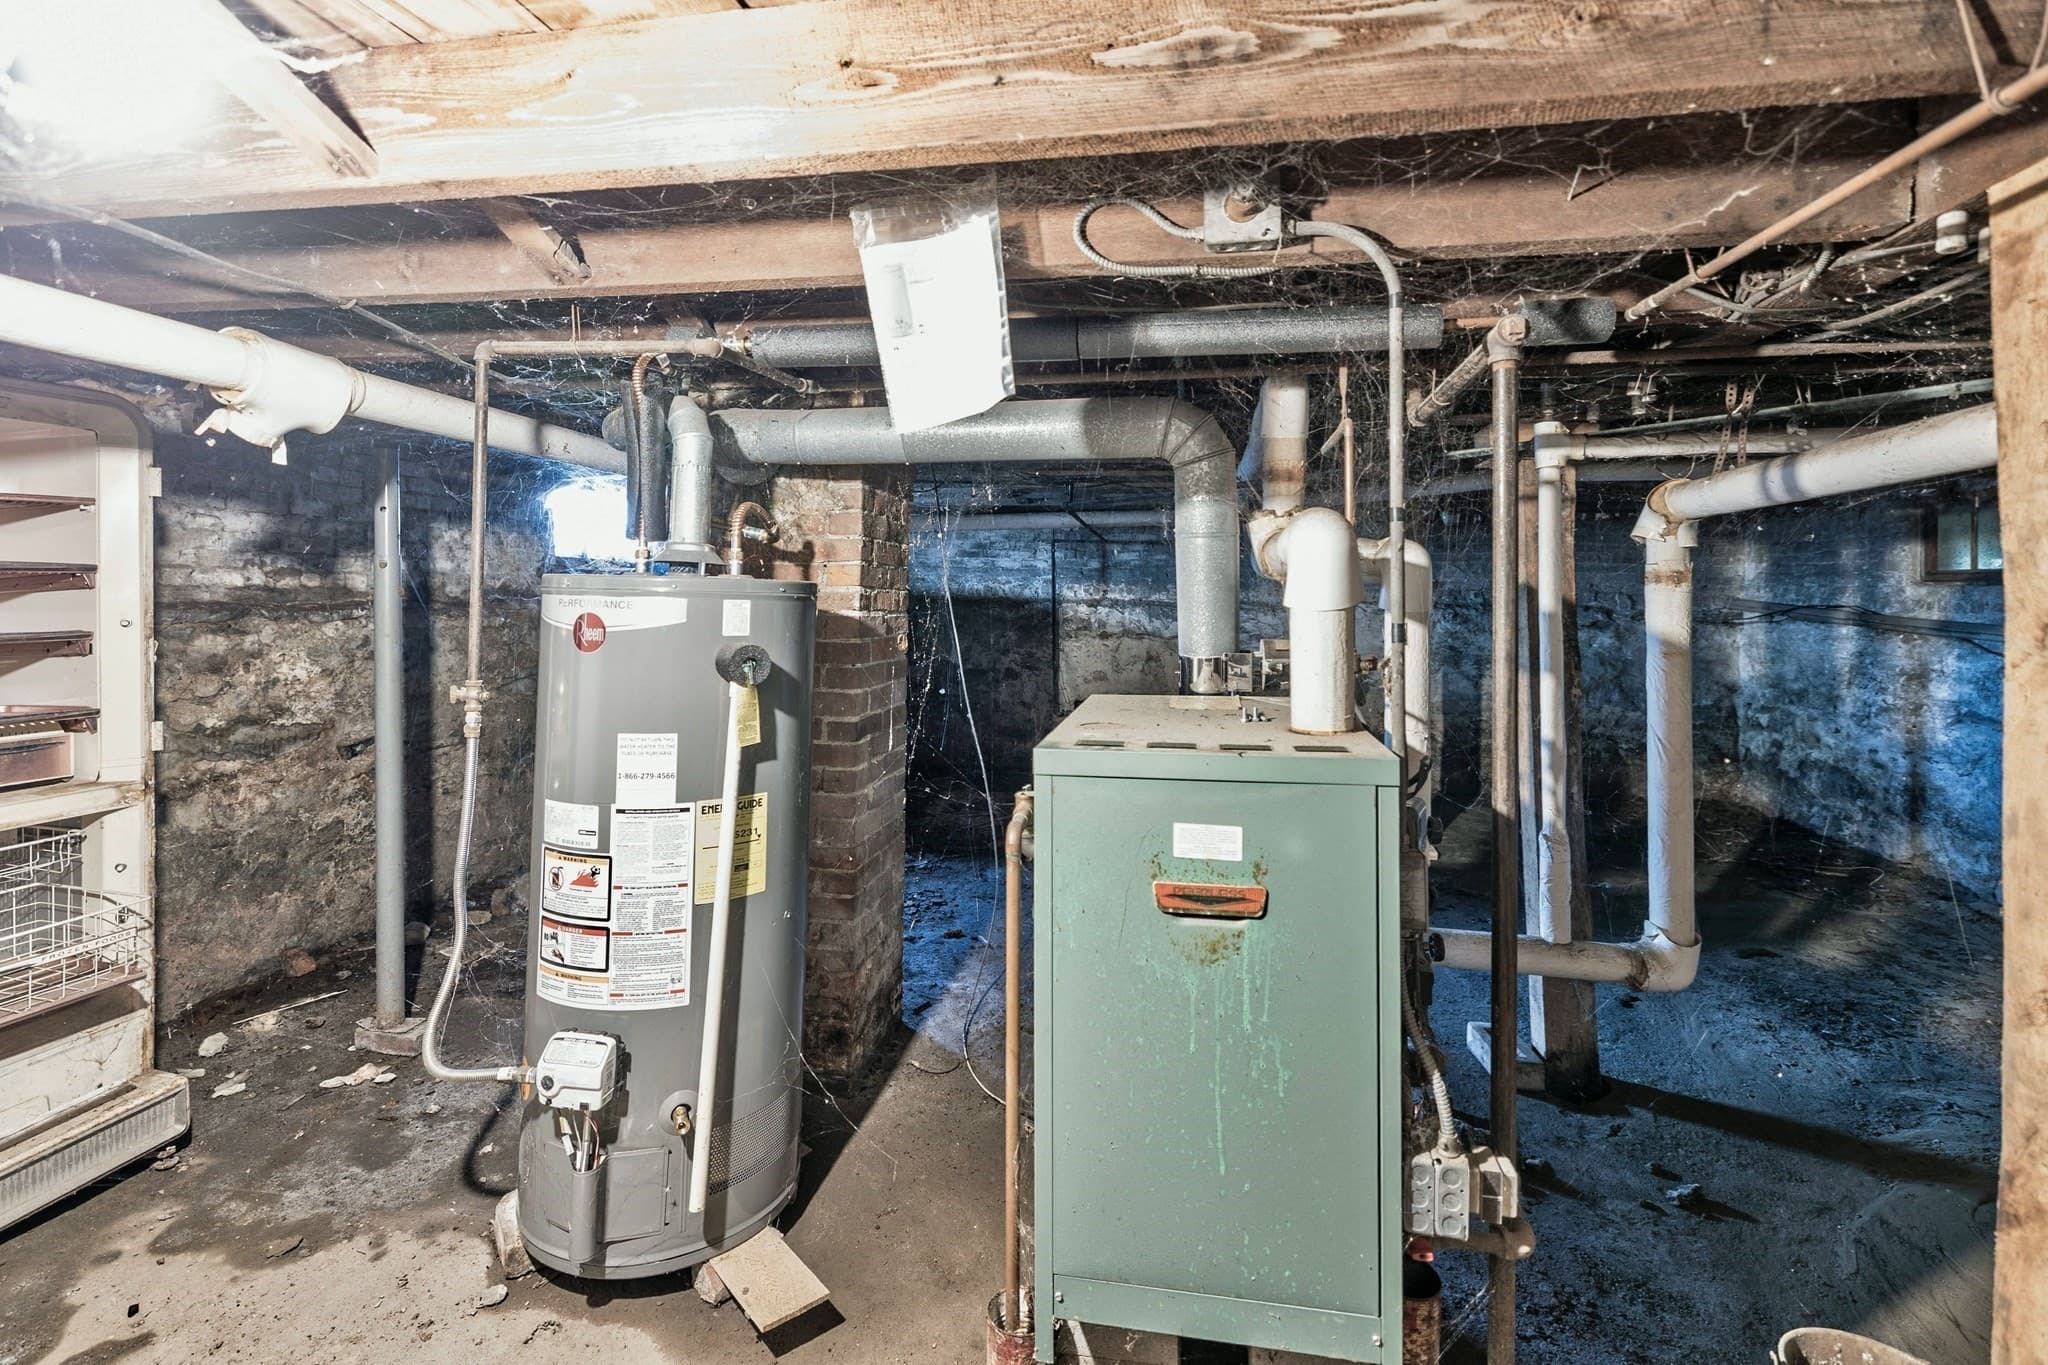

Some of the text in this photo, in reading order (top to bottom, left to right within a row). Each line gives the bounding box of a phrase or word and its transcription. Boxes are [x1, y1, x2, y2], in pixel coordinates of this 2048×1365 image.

[558, 598, 633, 610] PERFOANCE
[576, 612, 605, 647] Rheem
[618, 772, 675, 780] 1-866-279-4566
[737, 798, 763, 811] GUIDE
[563, 856, 588, 864] WARNING
[1173, 886, 1247, 898] PEERLESS
[42, 931, 131, 961] FROZEN FOODS
